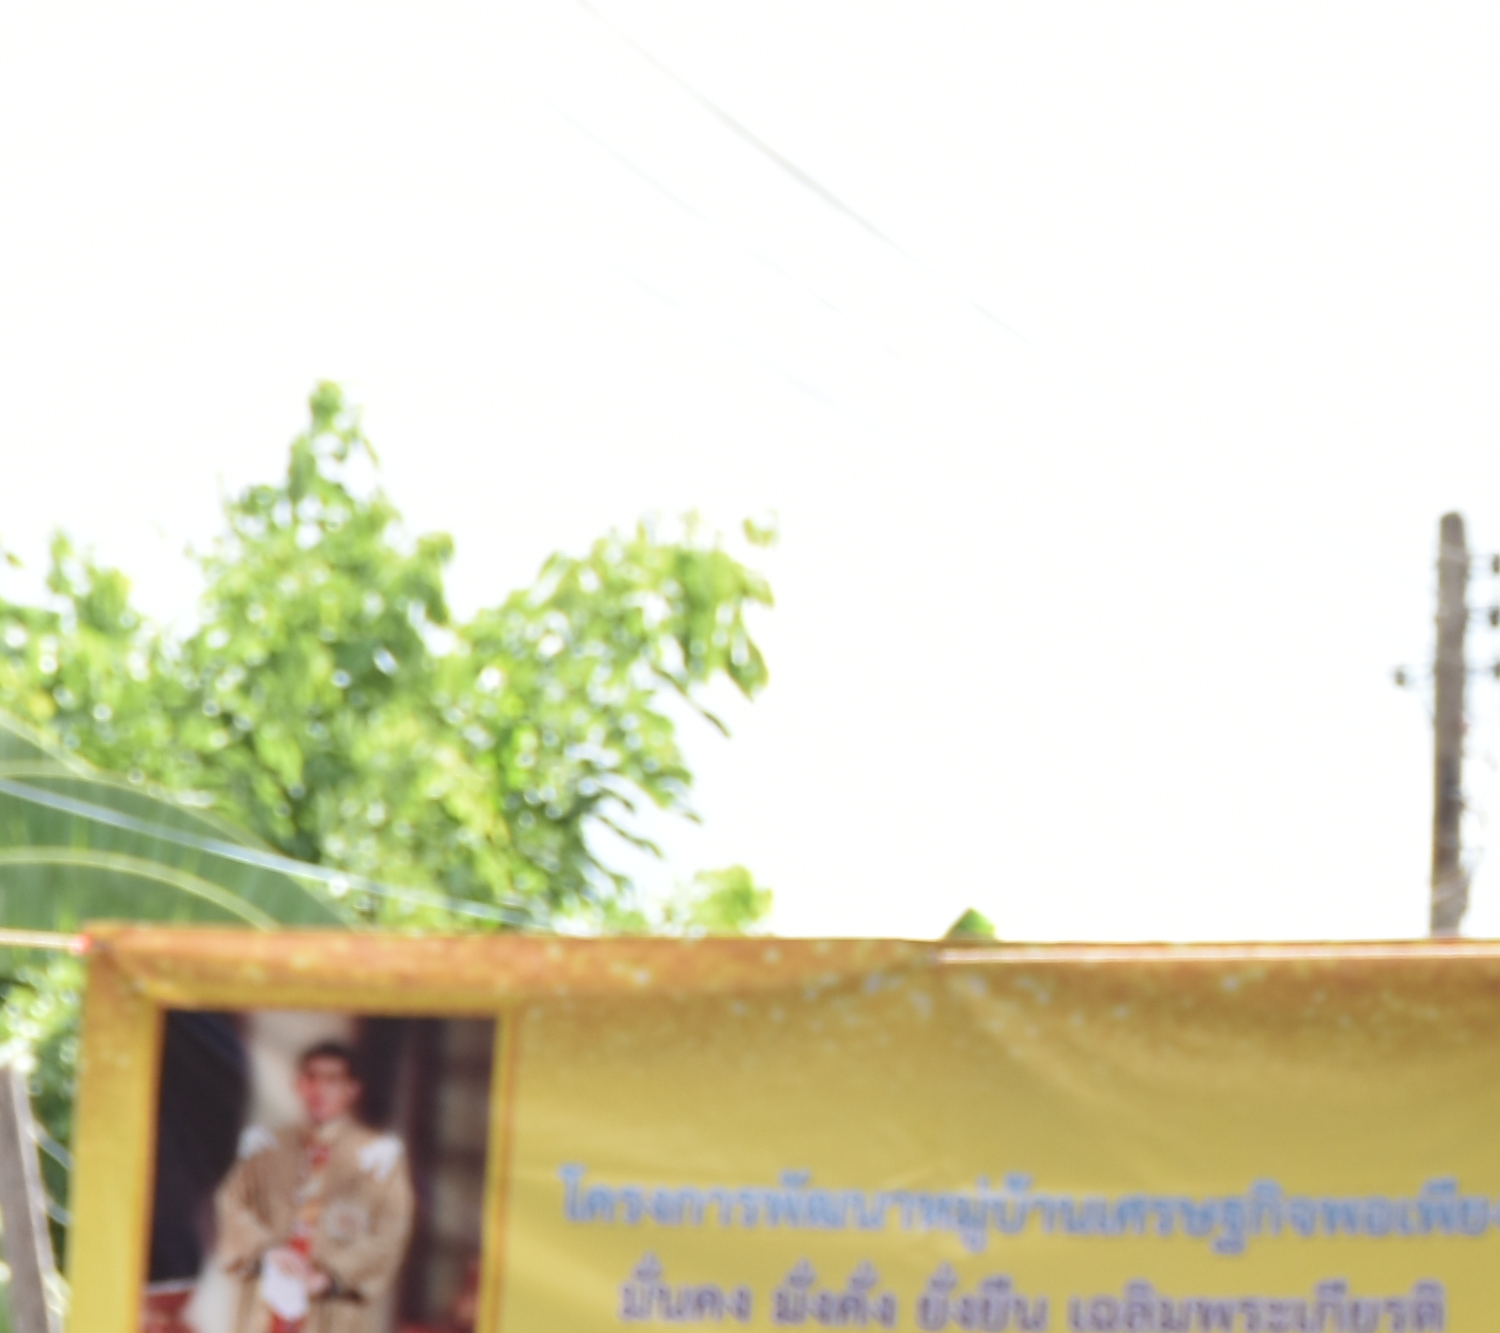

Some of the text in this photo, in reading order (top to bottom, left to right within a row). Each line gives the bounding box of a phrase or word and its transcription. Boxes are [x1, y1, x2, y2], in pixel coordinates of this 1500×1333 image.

[557, 1163, 1500, 1255] โครงการพัฒนาหมู่บ้านเศรษฐกิจพอเพีย
[619, 1250, 754, 1324] มั่นคง
[770, 1256, 899, 1330] มั่งคั่ง
[915, 1260, 1049, 1333] ยั่งยืน
